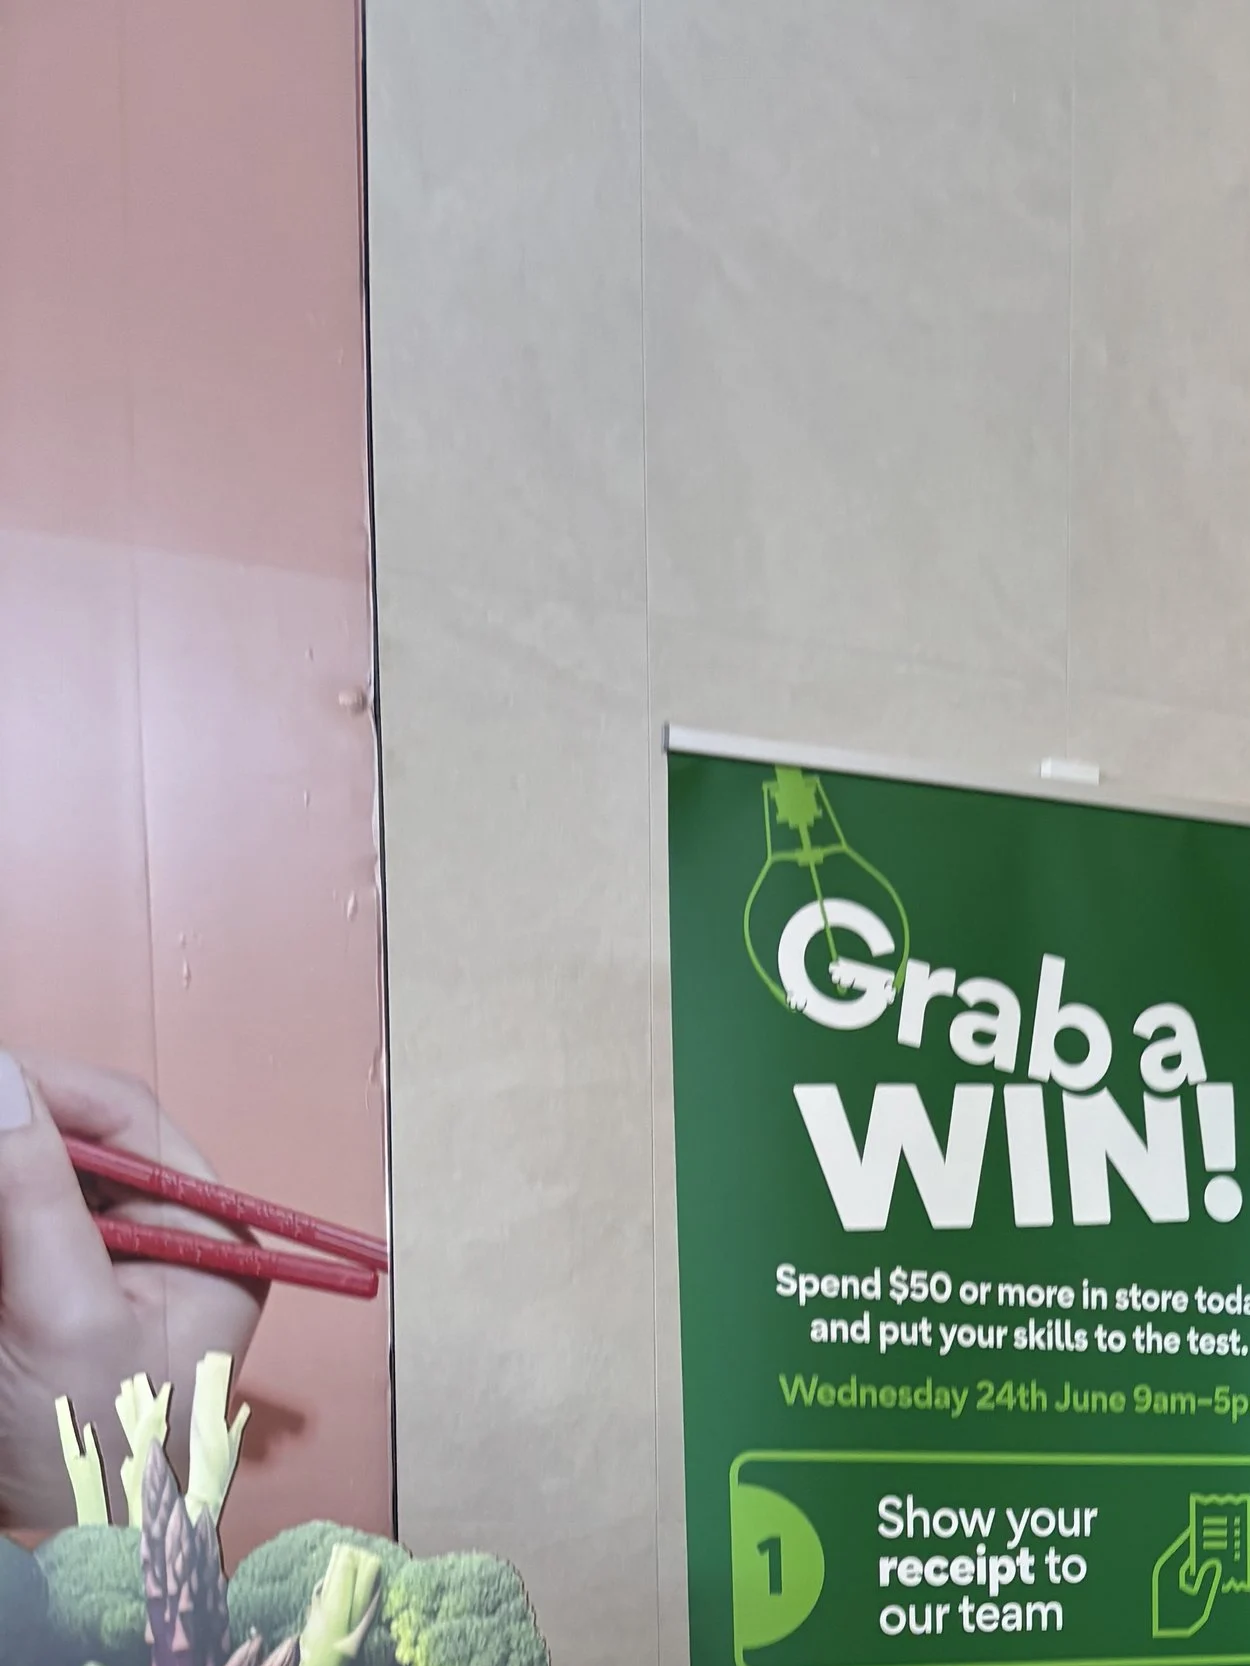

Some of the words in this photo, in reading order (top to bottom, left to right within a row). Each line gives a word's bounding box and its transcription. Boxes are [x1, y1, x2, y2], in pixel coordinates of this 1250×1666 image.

[777, 898, 1113, 1092] Grab
[1132, 1002, 1208, 1093] a
[792, 1082, 1243, 1232] WIN!
[776, 1263, 882, 1307] Spend
[889, 1265, 952, 1305] $50
[959, 1281, 992, 1305] or
[997, 1283, 1075, 1309] more
[1082, 1278, 1108, 1310] in
[1115, 1283, 1189, 1313] store
[810, 1310, 871, 1344] and
[879, 1317, 933, 1354] put
[939, 1323, 1008, 1356] your
[1013, 1317, 1089, 1352] skills
[1094, 1324, 1127, 1353] to
[1132, 1323, 1181, 1354] the
[1186, 1326, 1249, 1357] test.
[778, 1374, 969, 1418] Wednesday
[976, 1380, 1048, 1411] 24th
[1055, 1381, 1126, 1413] June
[877, 1494, 996, 1539] Show
[1005, 1507, 1098, 1549] your
[757, 1535, 783, 1596] 1
[879, 1544, 1035, 1597] receipt
[1044, 1547, 1087, 1584] to
[879, 1603, 951, 1635] our
[958, 1596, 1063, 1633] team
